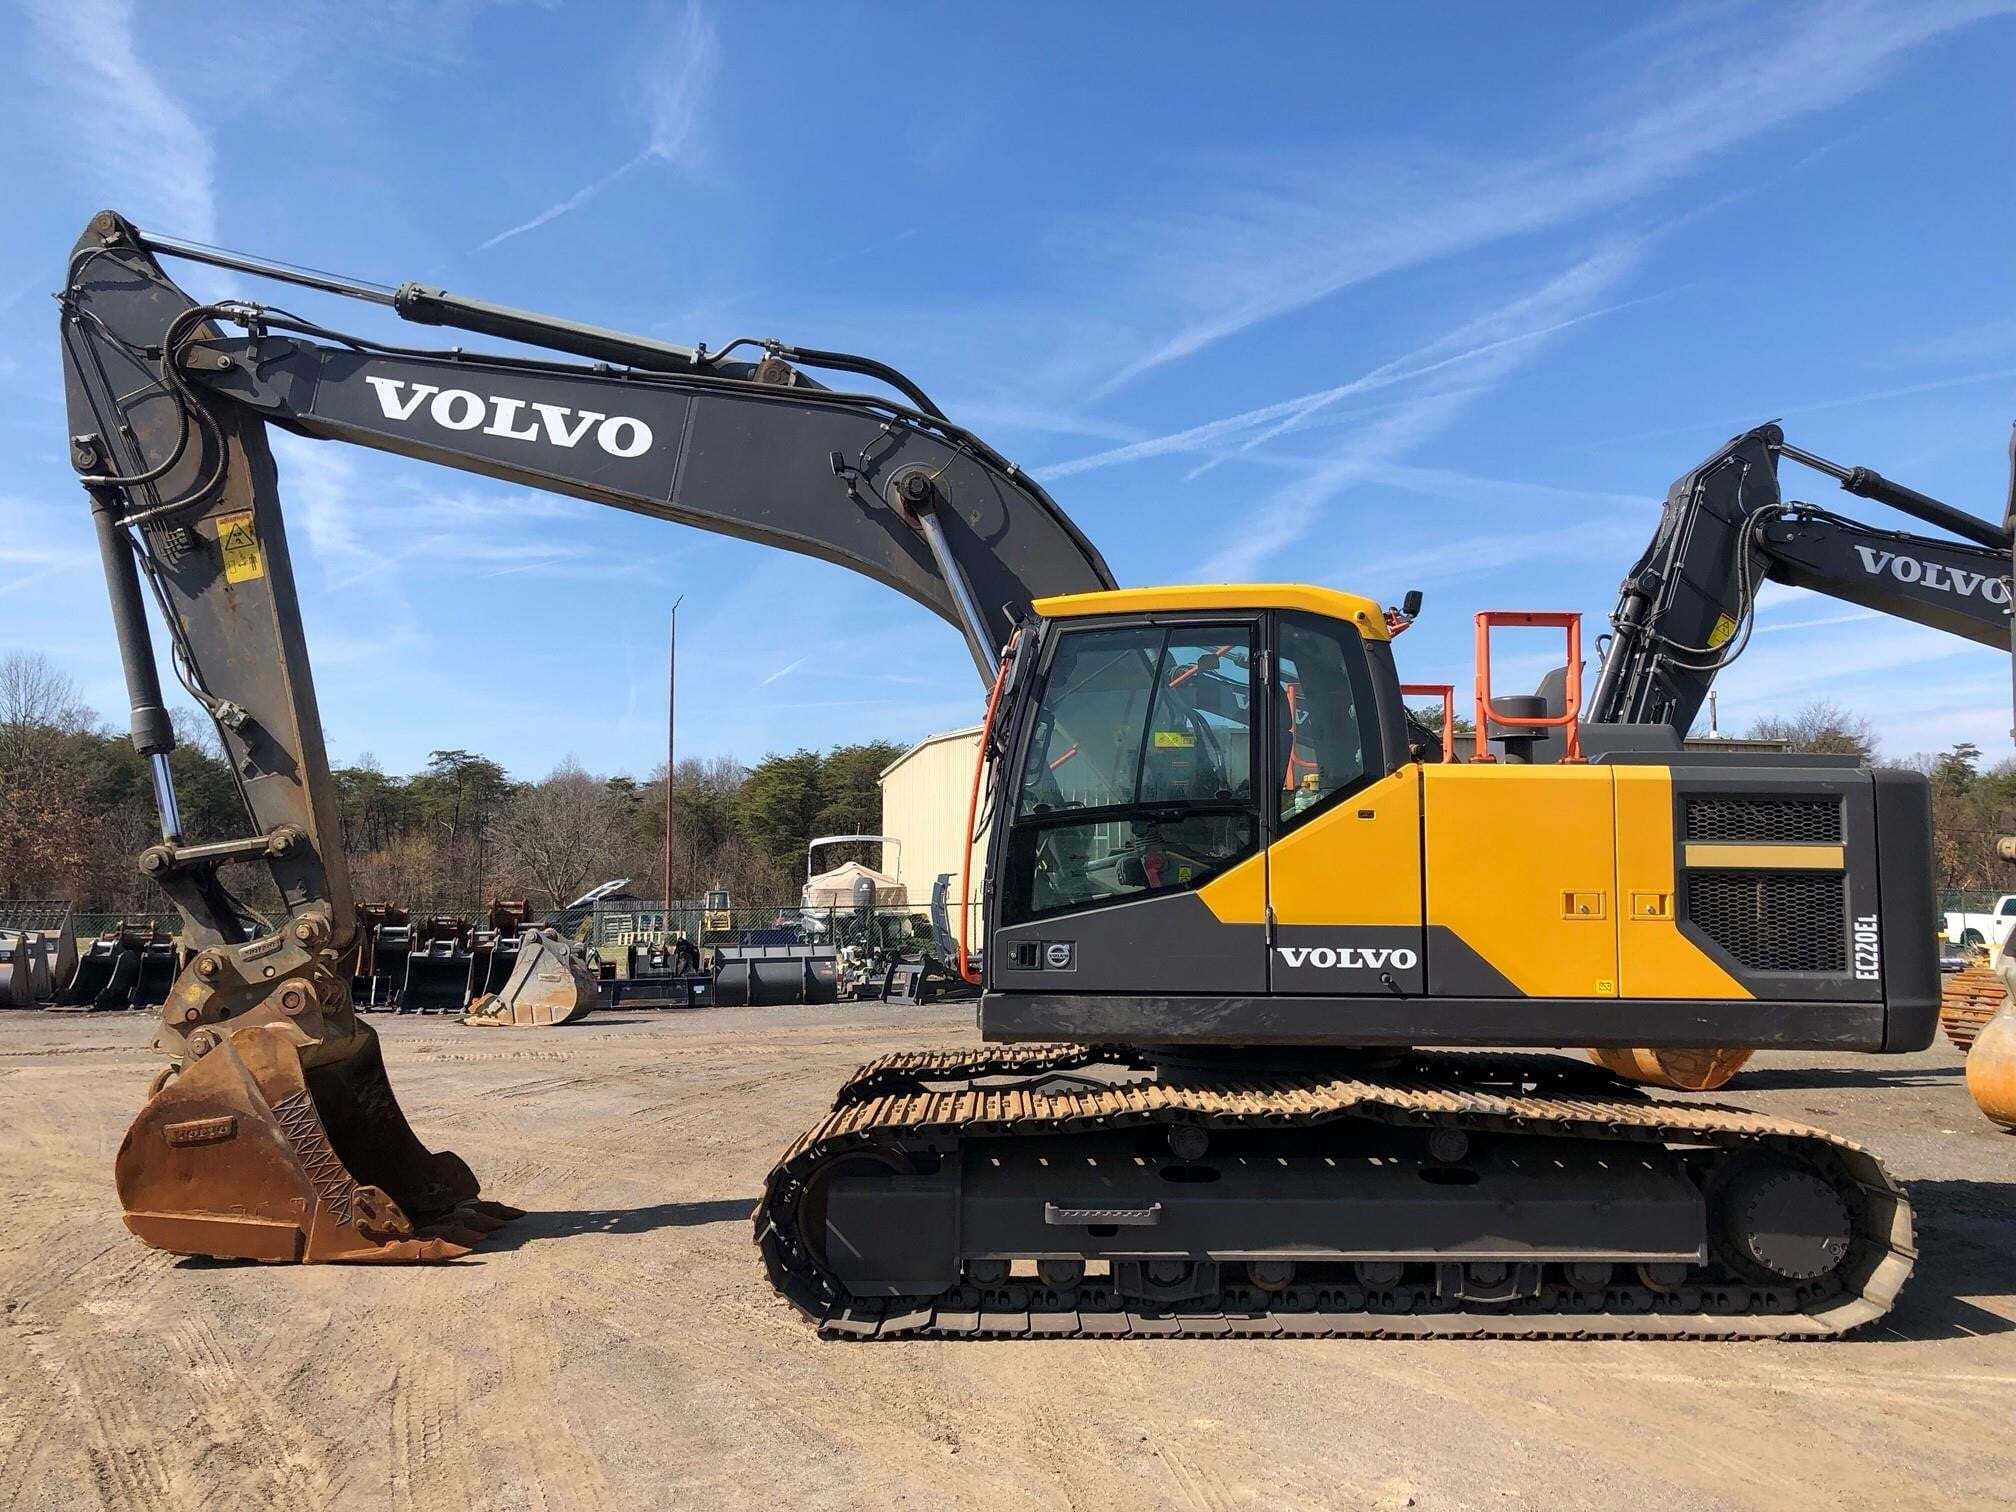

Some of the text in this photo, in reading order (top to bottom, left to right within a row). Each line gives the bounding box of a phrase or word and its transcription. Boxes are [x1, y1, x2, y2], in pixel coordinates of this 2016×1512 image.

[365, 376, 653, 458] VOLVO
[1854, 544, 2012, 604] VOLVO
[1277, 948, 1417, 969] VOLVO
[1854, 914, 1879, 980] EC220EL
